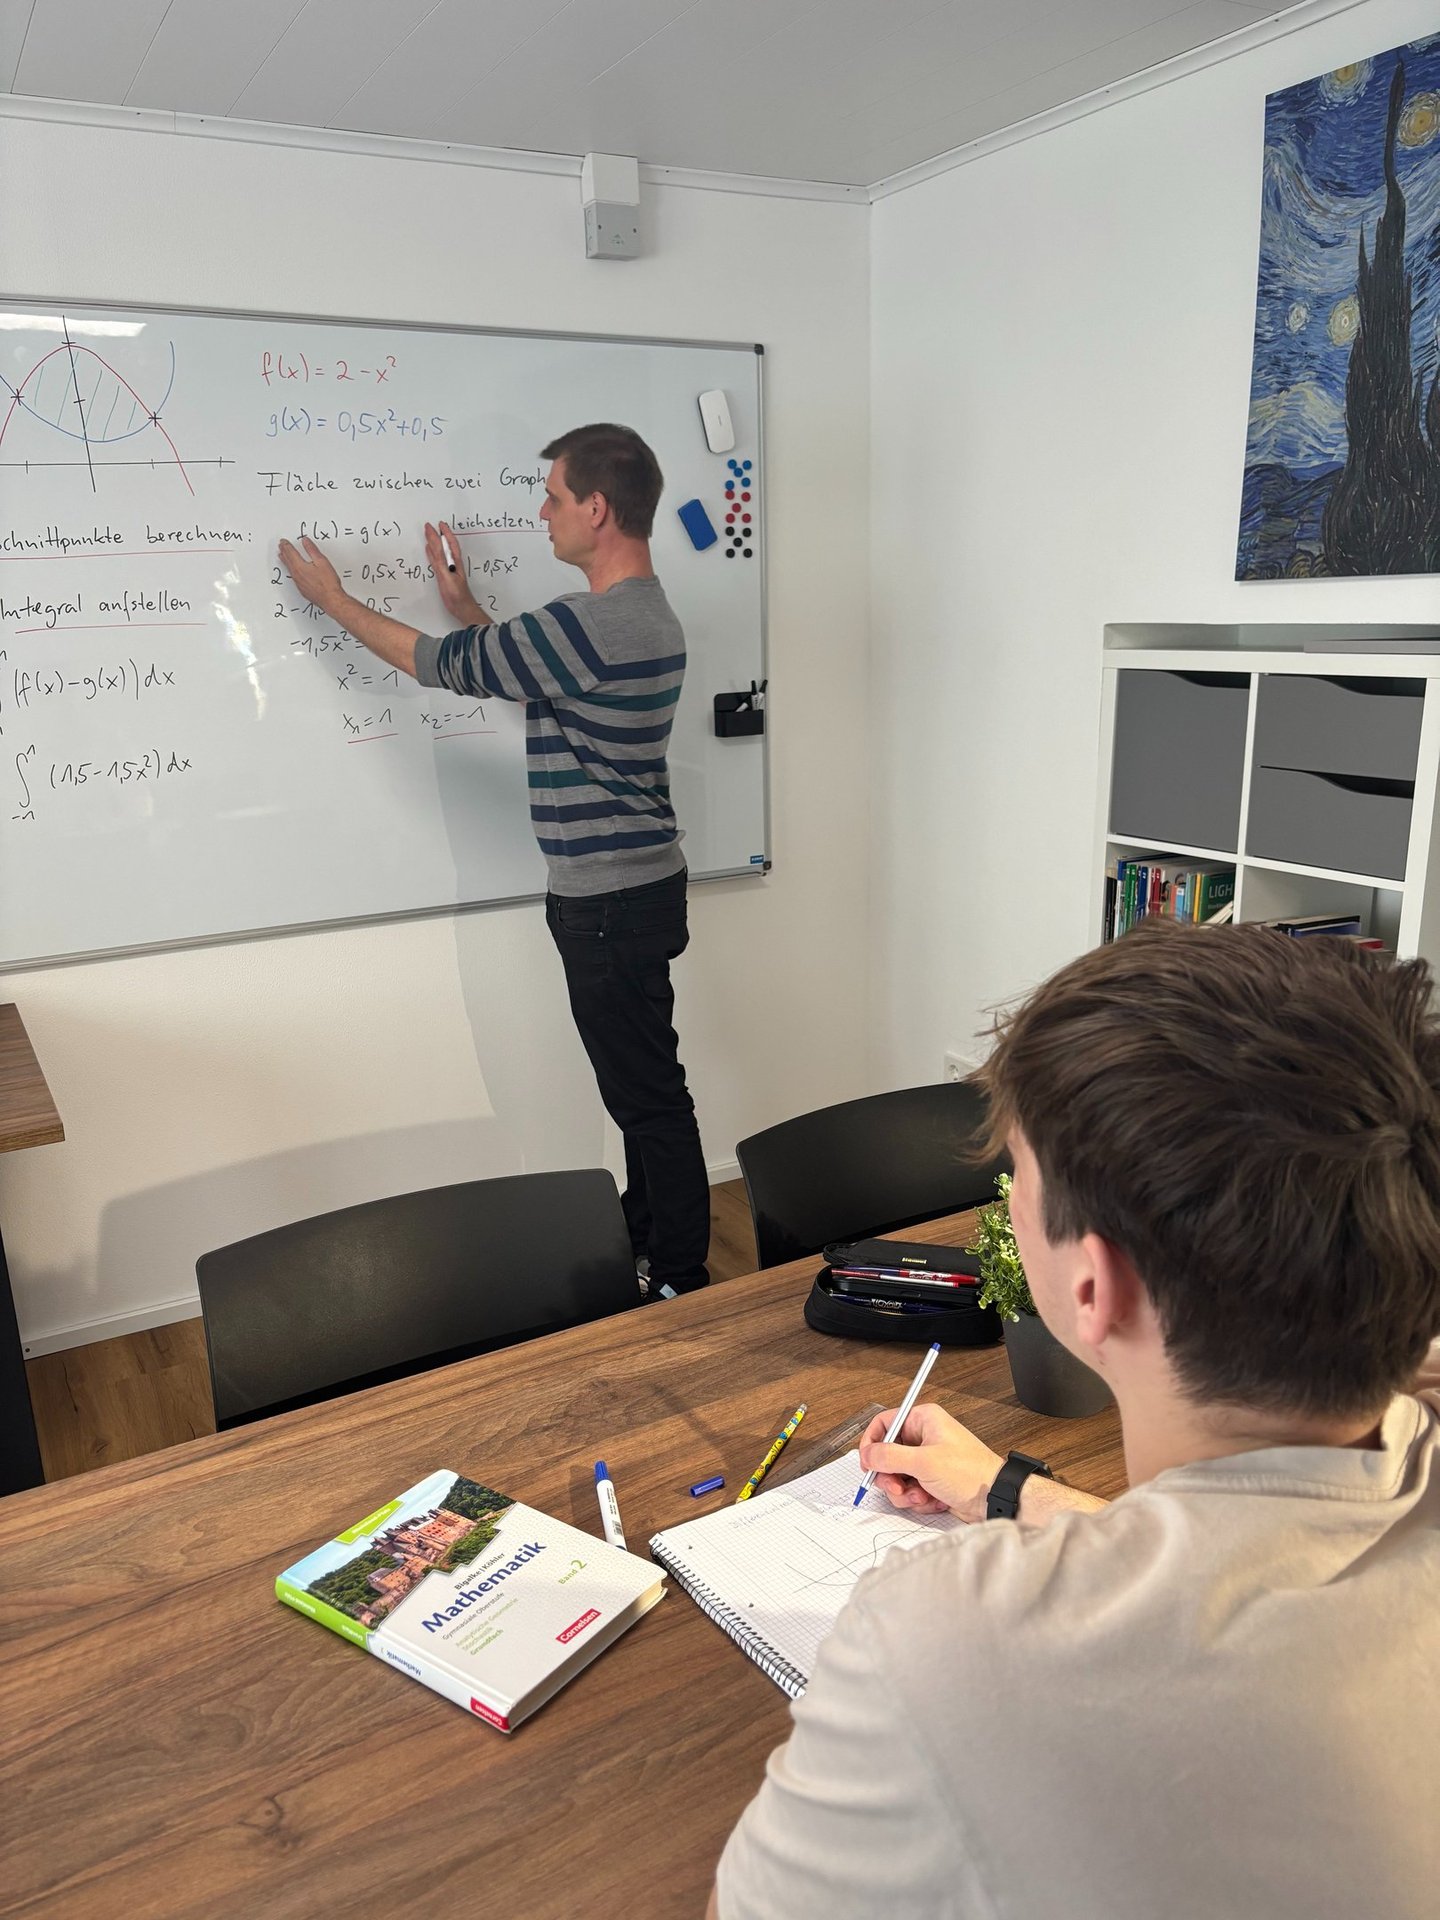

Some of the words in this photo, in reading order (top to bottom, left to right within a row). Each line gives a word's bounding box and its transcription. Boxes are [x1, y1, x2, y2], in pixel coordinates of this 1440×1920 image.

[336, 360, 354, 381] 2
[257, 472, 339, 496] Fläche
[353, 475, 434, 490] zwischen
[444, 472, 482, 489] zwei
[446, 511, 543, 531] leichsetzen
[0, 525, 124, 554] chnittpunkte
[0, 593, 82, 629] Integral
[98, 591, 191, 622] aufstellen
[454, 1569, 482, 1591] Bigalke
[483, 1552, 505, 1570] Köhler
[557, 1569, 578, 1585] Band
[570, 1559, 588, 1570] 2
[421, 1541, 548, 1634] Mathematik
[559, 1611, 598, 1642] Cornelsen
[474, 1703, 503, 1727] Cornelsen
